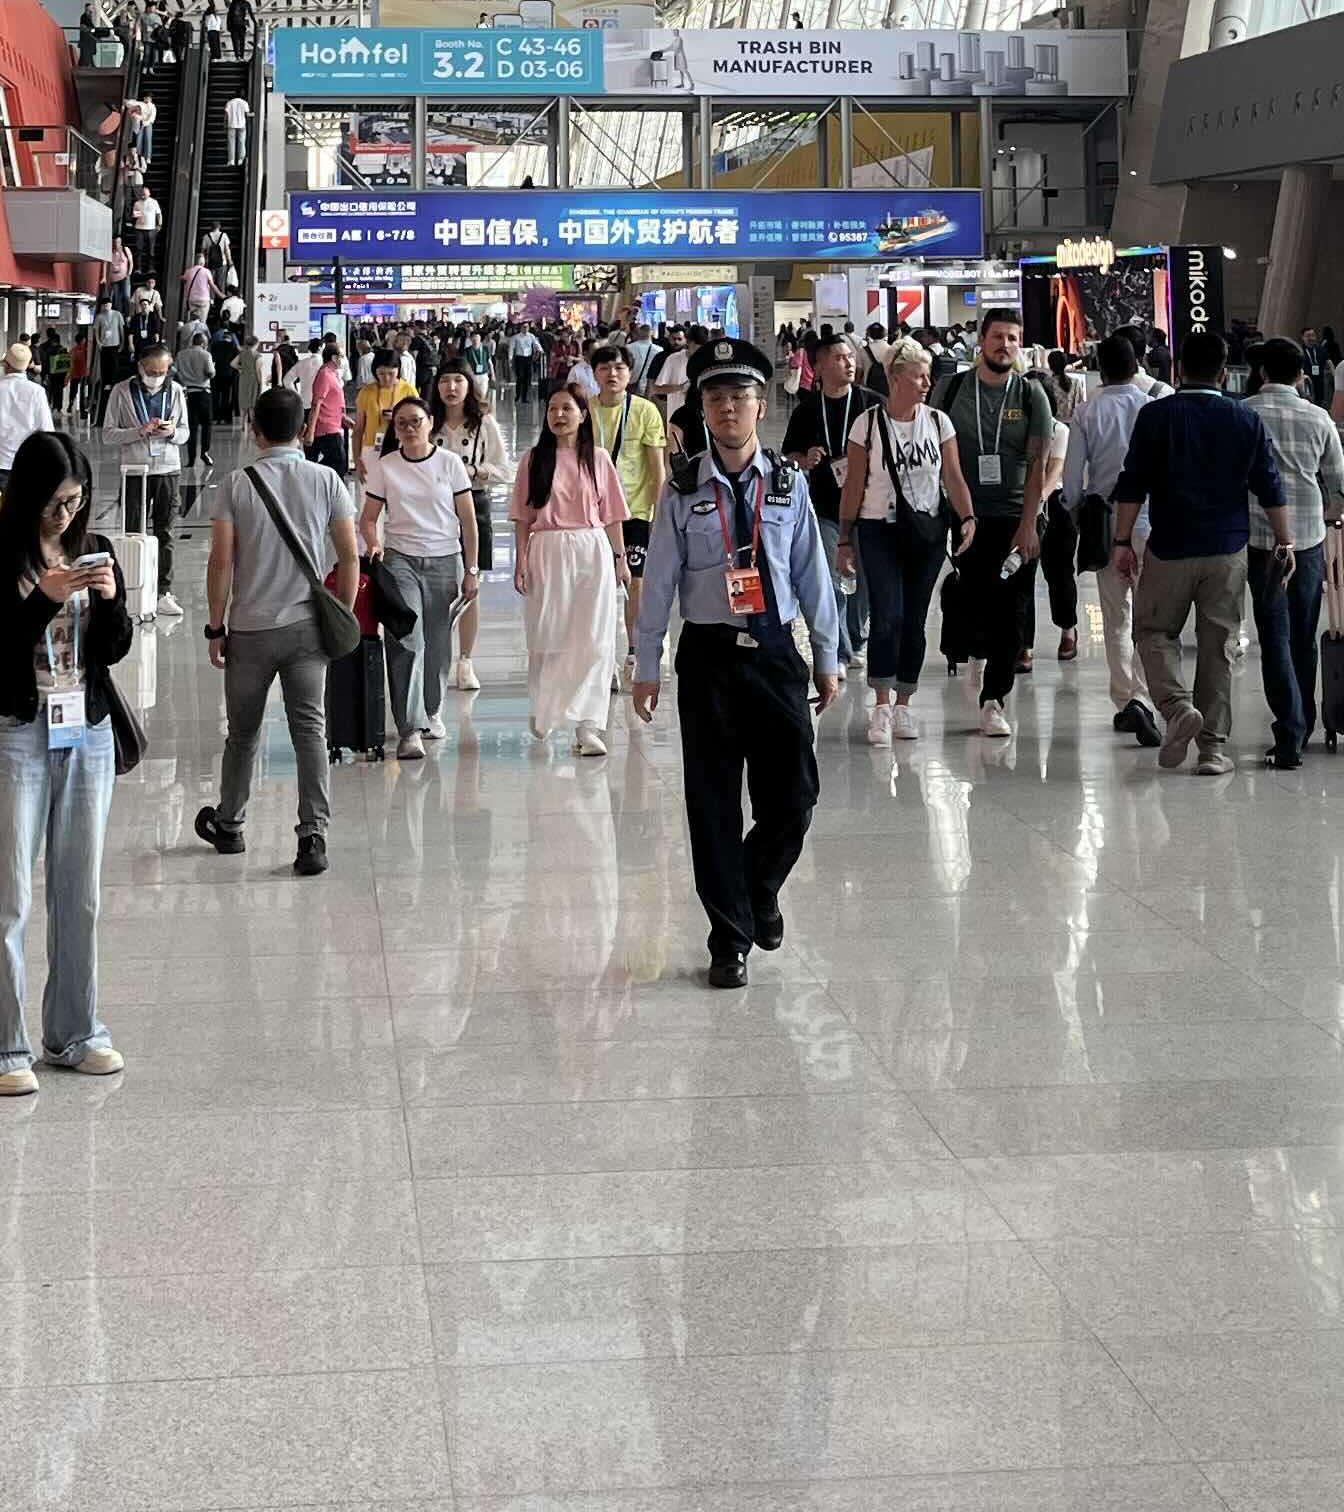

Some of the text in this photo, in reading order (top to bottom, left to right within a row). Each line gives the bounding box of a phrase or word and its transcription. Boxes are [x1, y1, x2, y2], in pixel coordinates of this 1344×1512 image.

[434, 40, 465, 49] Booth
[496, 37, 581, 56] C 43-46
[737, 40, 841, 55] TRASH BIN
[432, 51, 485, 79] 3.2
[498, 61, 583, 78] D 03-06
[713, 59, 873, 75] MANUFACTURER
